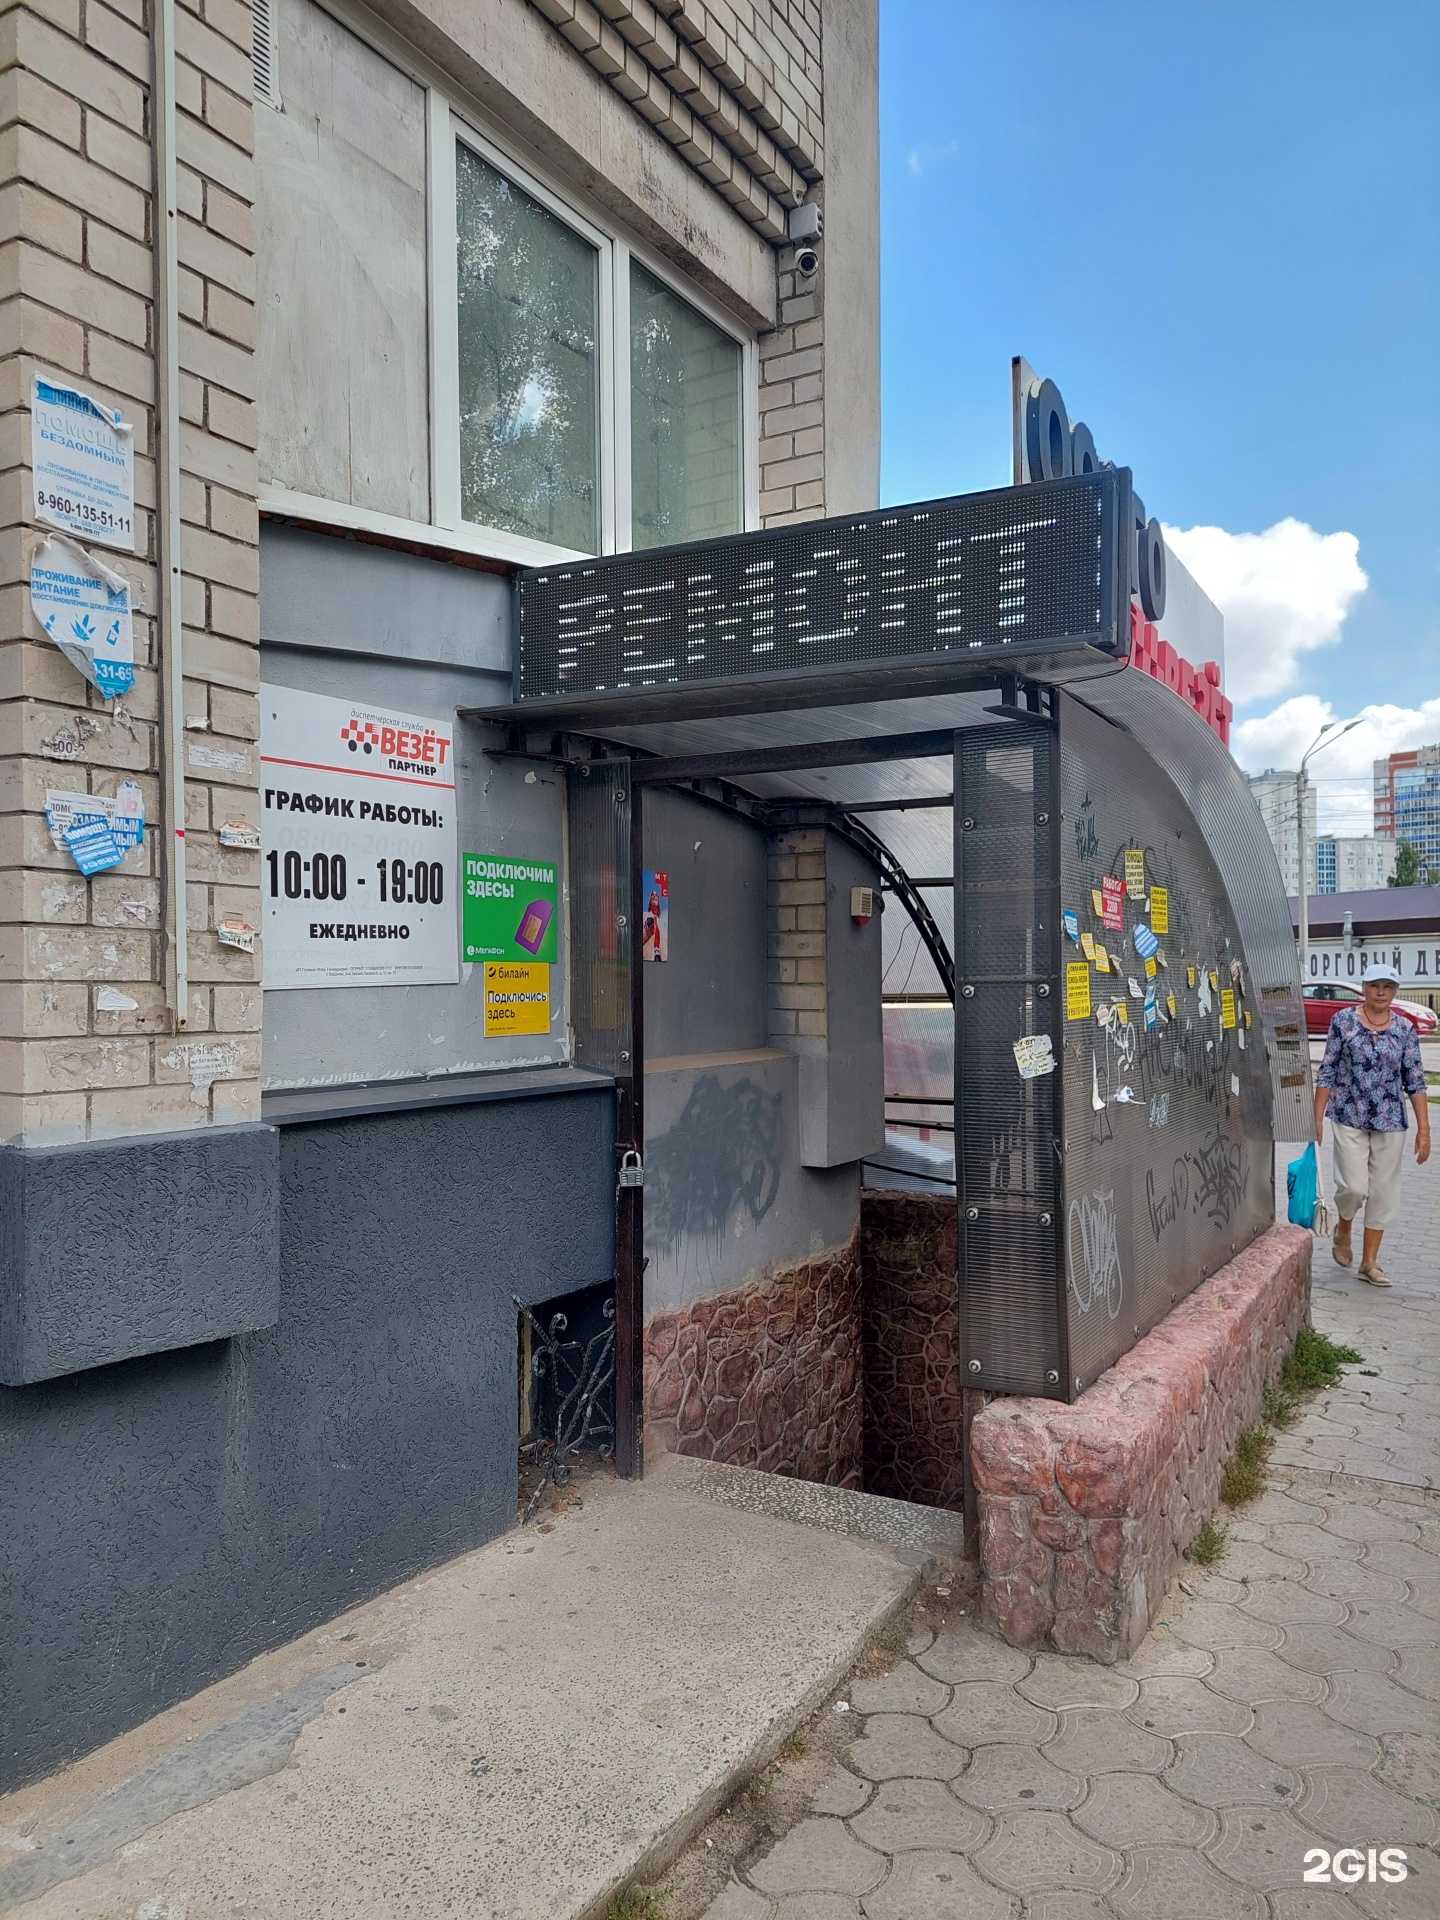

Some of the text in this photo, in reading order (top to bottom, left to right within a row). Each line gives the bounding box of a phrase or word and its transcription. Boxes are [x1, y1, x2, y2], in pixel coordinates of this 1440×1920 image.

[40, 429, 126, 467] БЕЗДОМНЫМ
[37, 490, 131, 533] 8-960-135-51-11
[31, 568, 103, 591] ПРОЖИВАНИЕ
[31, 581, 81, 598] ПИТАНИЕ
[558, 519, 1057, 680] РЕМОНТ
[380, 727, 450, 765] ВЕЗЁТ
[388, 758, 437, 777] ПАРТНЕР
[264, 788, 444, 829] ГРАФИК РАБОТЫ:
[266, 849, 347, 901] 10:00
[376, 858, 443, 905] 19:00
[466, 860, 554, 884] ПОДКЛЮЧИМ
[466, 880, 515, 898] ЗДЕСЬ!
[309, 923, 410, 941] ЕЖЕДНЕВНО
[498, 967, 529, 979] билайн
[487, 990, 547, 1004] Подключись
[487, 1009, 516, 1021] здесь
